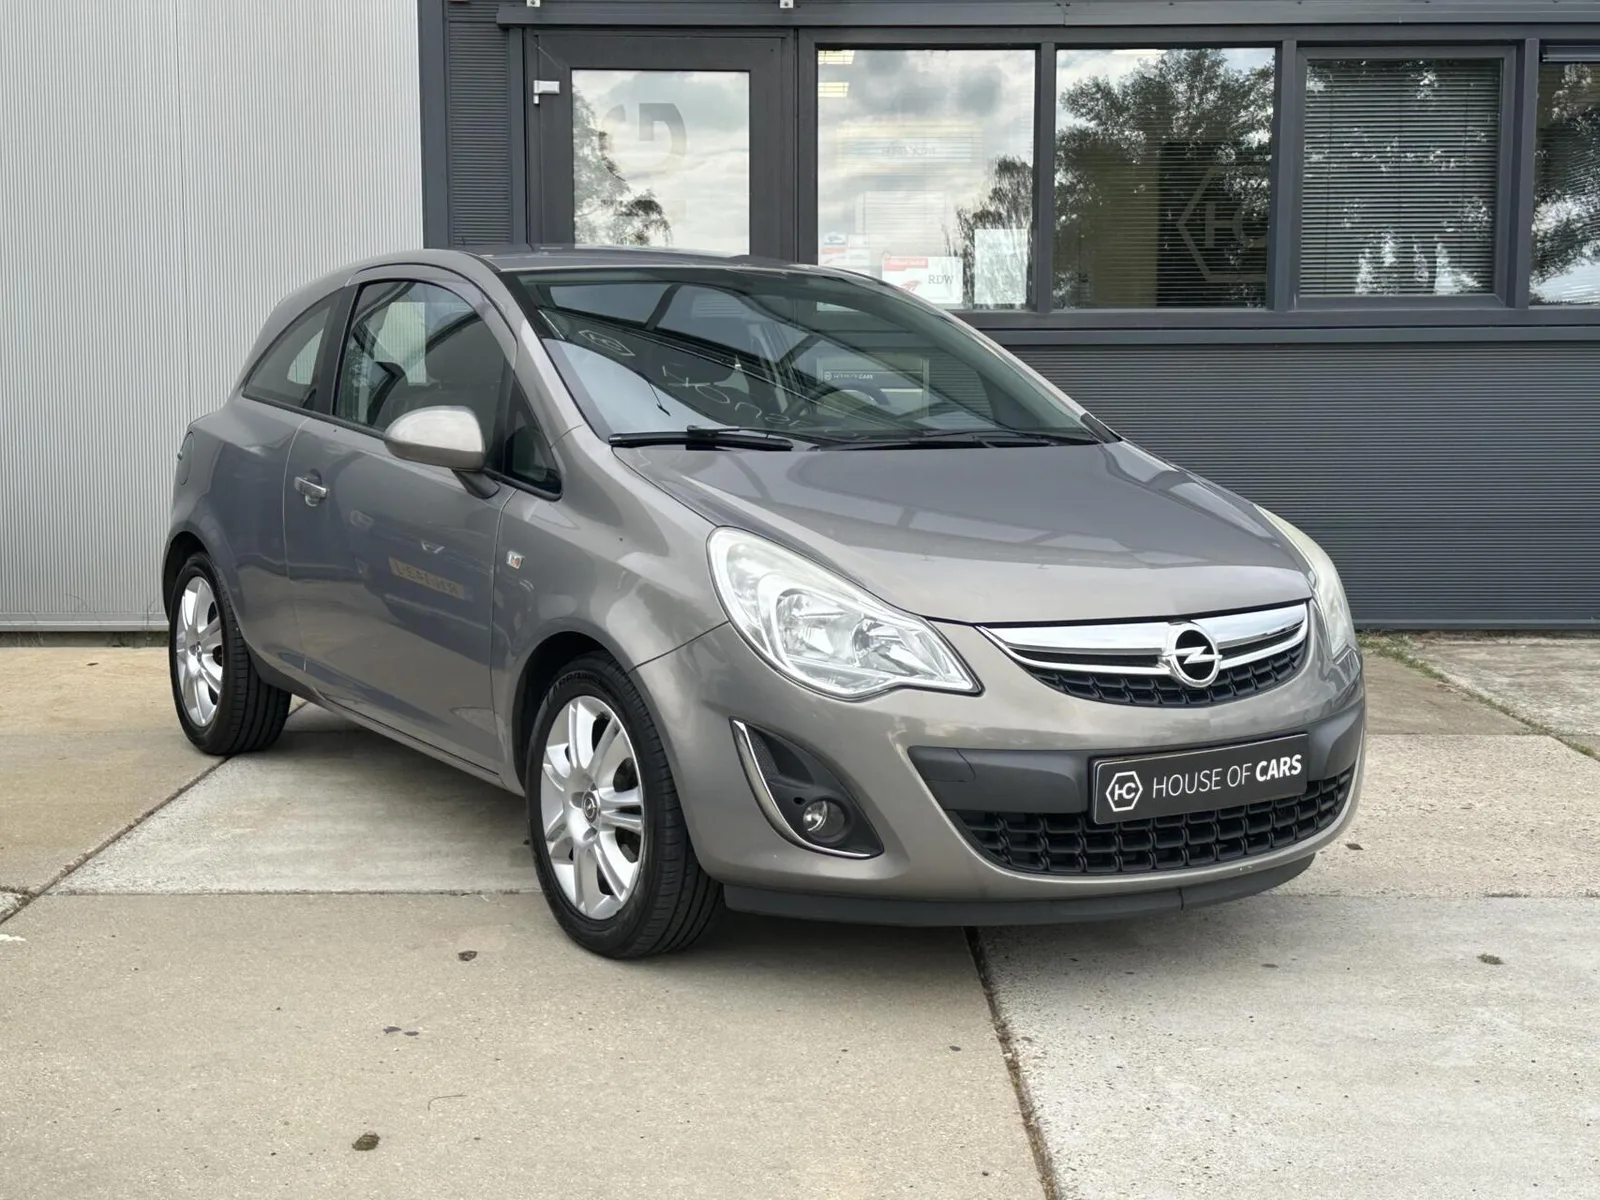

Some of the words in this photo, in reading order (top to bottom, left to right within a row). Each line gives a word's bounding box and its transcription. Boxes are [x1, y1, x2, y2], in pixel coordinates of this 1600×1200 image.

[928, 274, 954, 285] RDW
[1152, 768, 1223, 799] HOUSE
[1227, 763, 1253, 788] OF
[1255, 754, 1303, 783] CARS
